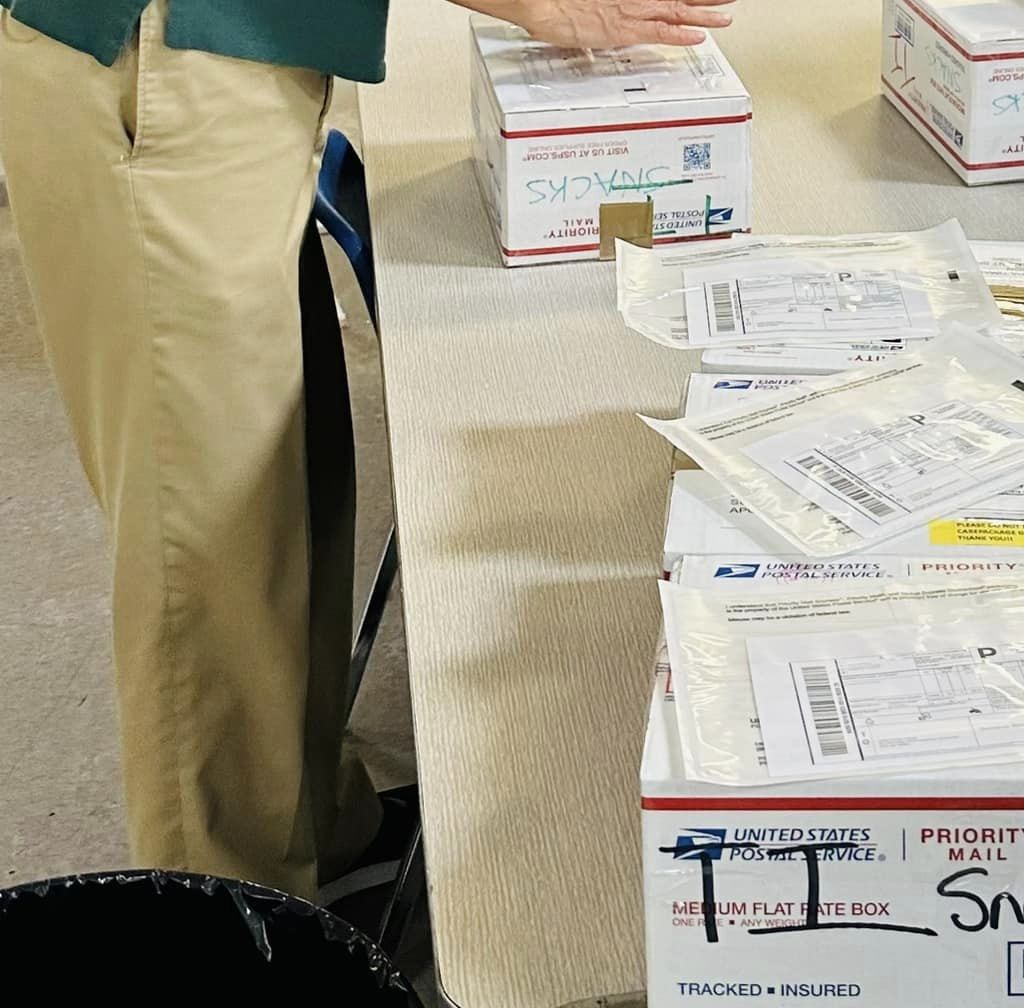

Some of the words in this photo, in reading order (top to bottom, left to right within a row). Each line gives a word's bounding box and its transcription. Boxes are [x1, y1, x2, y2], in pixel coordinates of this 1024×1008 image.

[579, 149, 590, 158] AT
[591, 148, 605, 157] US
[607, 147, 629, 156] VISIT
[526, 166, 671, 205] SNACKS
[670, 211, 705, 220] POSTAL
[563, 218, 594, 226] MAIL
[667, 220, 703, 229] UNITED
[549, 225, 600, 239] RIORITY
[838, 272, 852, 281] P
[908, 414, 925, 425] P
[921, 563, 1017, 571] PRIORITY
[818, 571, 885, 579] SERVICE
[977, 647, 997, 658] P
[734, 828, 804, 841] UNITED
[806, 828, 871, 841] STATES
[729, 847, 796, 861] POSTAL
[949, 848, 1008, 861] MAIL
[672, 901, 747, 916] MEIUM
[753, 902, 794, 916] FLAT
[851, 902, 890, 916] BOX
[672, 918, 694, 927] ONE
[697, 918, 724, 927] RE
[740, 918, 762, 927] ANY
[764, 918, 808, 927] WEIGHT
[677, 983, 762, 996] TRACKED
[780, 984, 861, 997] INSURED
